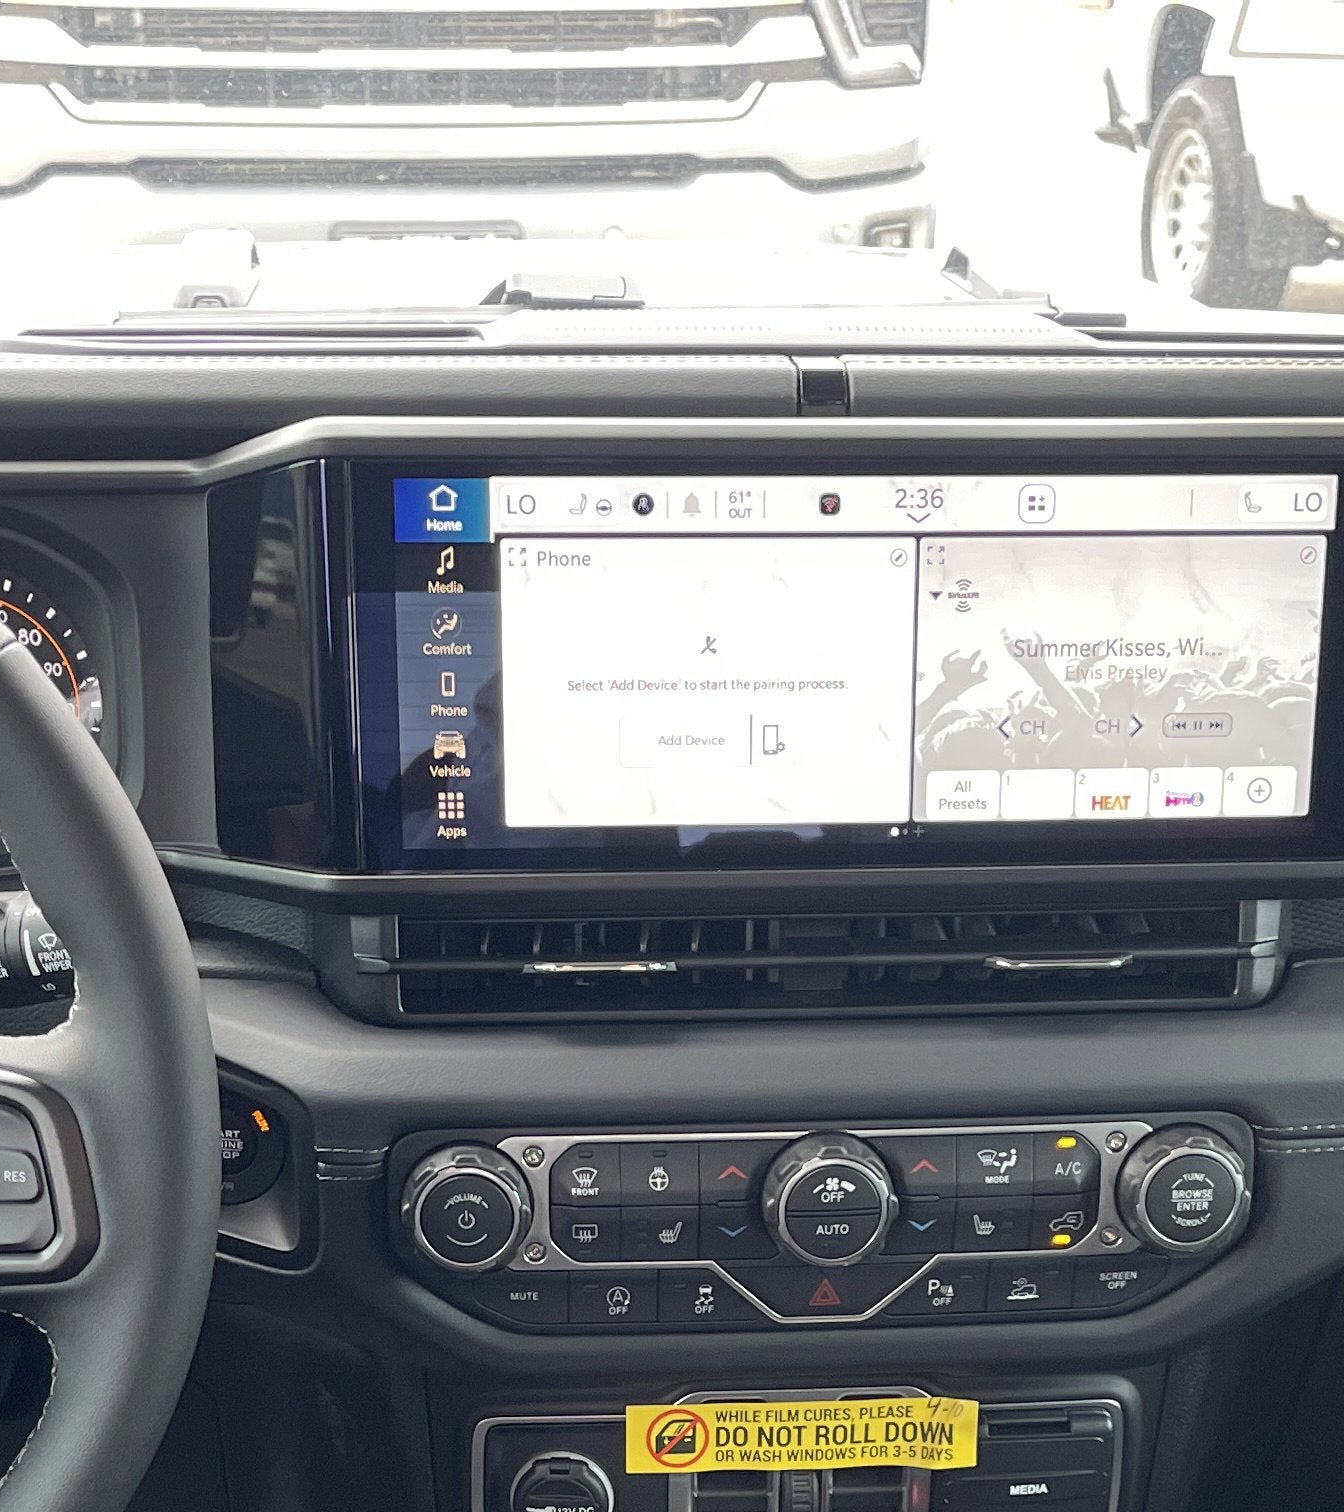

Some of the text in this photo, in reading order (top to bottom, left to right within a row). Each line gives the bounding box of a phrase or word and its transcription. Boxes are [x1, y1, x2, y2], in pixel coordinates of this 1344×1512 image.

[507, 494, 537, 514] LO
[894, 488, 945, 511] 2:36
[1293, 493, 1322, 513] LO
[729, 508, 752, 519] OUT
[426, 519, 463, 532] Home
[536, 551, 591, 569] Phone
[427, 581, 464, 594] Media
[17, 629, 42, 646] 80
[422, 642, 472, 656] Comfort
[1013, 638, 1100, 659] Summer
[1106, 638, 1172, 659] Kisses,
[43, 663, 62, 676] 90
[1065, 665, 1168, 682] Elvis Presley
[567, 679, 604, 691] Select
[684, 680, 697, 691] to
[699, 679, 728, 690] start
[731, 678, 751, 690] the
[753, 678, 795, 692] pairing
[798, 680, 849, 692] process.
[430, 704, 468, 717] Phone
[1019, 719, 1045, 735] CH
[1094, 718, 1121, 734] CH
[658, 735, 726, 746] Add Device
[429, 765, 471, 778] Vehicle
[1226, 772, 1235, 783] 4
[1078, 774, 1086, 785] 2
[1152, 773, 1160, 784] 3
[954, 780, 972, 793] All
[938, 797, 988, 810] Presets
[1090, 795, 1132, 811] HEAT
[437, 826, 467, 839] Apps
[38, 948, 71, 963] FRONT
[41, 961, 74, 974] WIPER
[219, 1129, 240, 1139] ART
[1054, 1161, 1082, 1175] A/C
[3, 1170, 27, 1184] RES
[985, 1175, 1009, 1184] MODE
[1182, 1173, 1206, 1182] TUNE
[571, 1187, 599, 1196] FRONT
[821, 1191, 845, 1204] OFF
[1172, 1189, 1213, 1200] BROWSE
[448, 1193, 483, 1205] VOLUME
[1176, 1201, 1209, 1211] ENTER
[1175, 1216, 1207, 1227] SCROLL
[815, 1223, 850, 1236] AUTO
[1099, 1271, 1138, 1282] SCREEN
[1107, 1280, 1126, 1290] OFF
[510, 1291, 539, 1301] MUTE
[933, 1296, 952, 1306] OFF
[608, 1304, 629, 1315] OFF
[694, 1303, 715, 1315] OFF
[716, 1406, 913, 1423] WHILE FILM CURES, PLEASE
[716, 1422, 954, 1446] DO NOT ROLL DOWN
[716, 1446, 954, 1462] OR WASH WINDOWS FOR 3-5 DAYS
[1009, 1483, 1048, 1496] MEDIA
